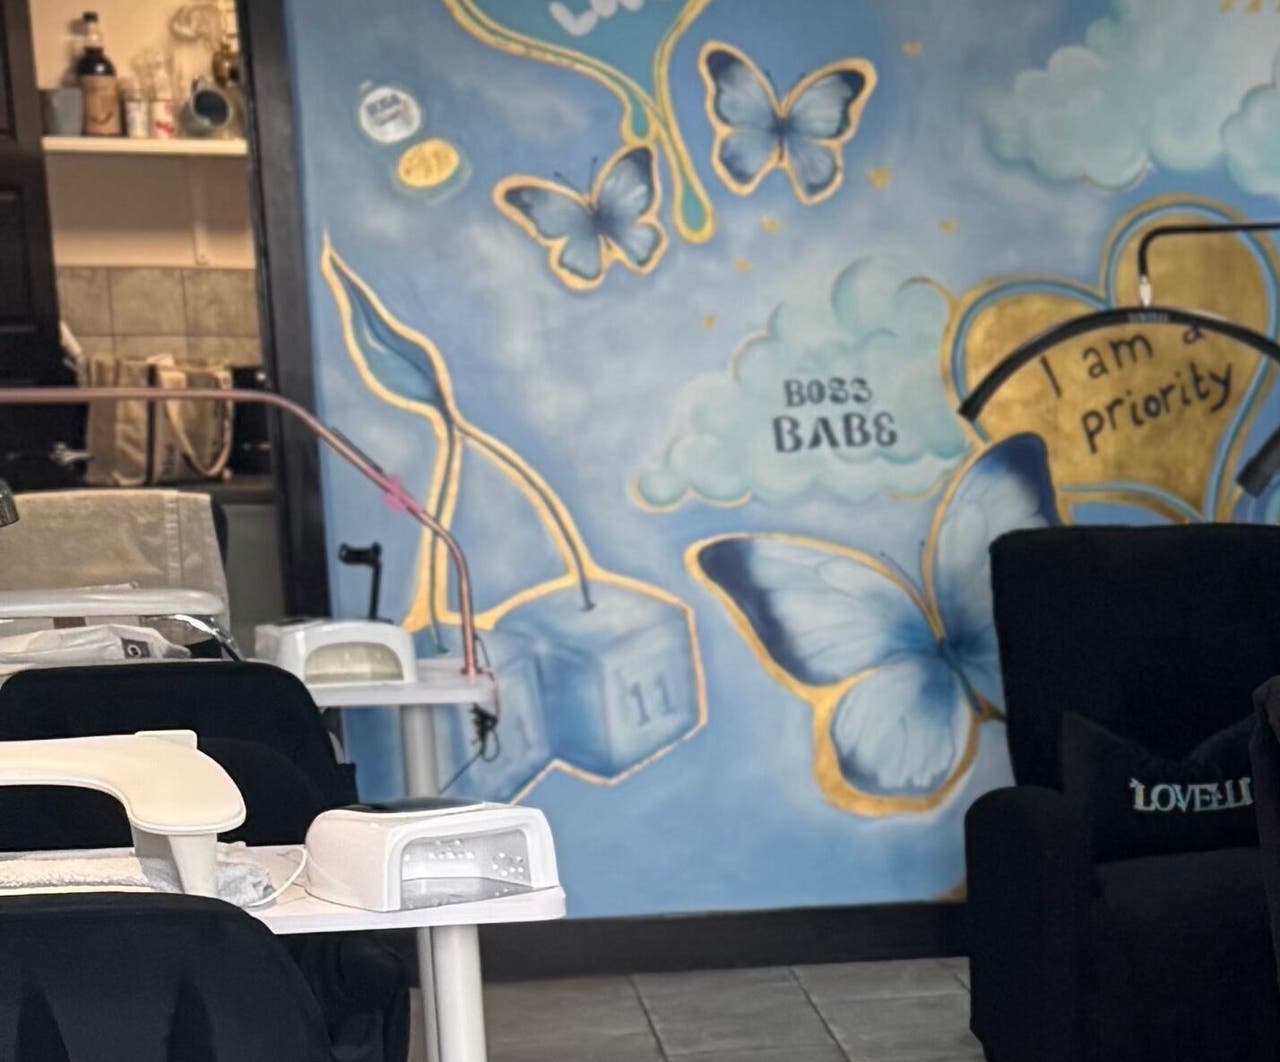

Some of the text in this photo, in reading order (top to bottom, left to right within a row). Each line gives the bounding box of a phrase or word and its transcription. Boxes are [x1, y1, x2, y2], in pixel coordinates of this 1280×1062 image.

[1039, 327, 1205, 398] I am a
[783, 377, 873, 407] BOSS
[1081, 360, 1232, 454] priority
[1129, 776, 1254, 813] LOVELLI
